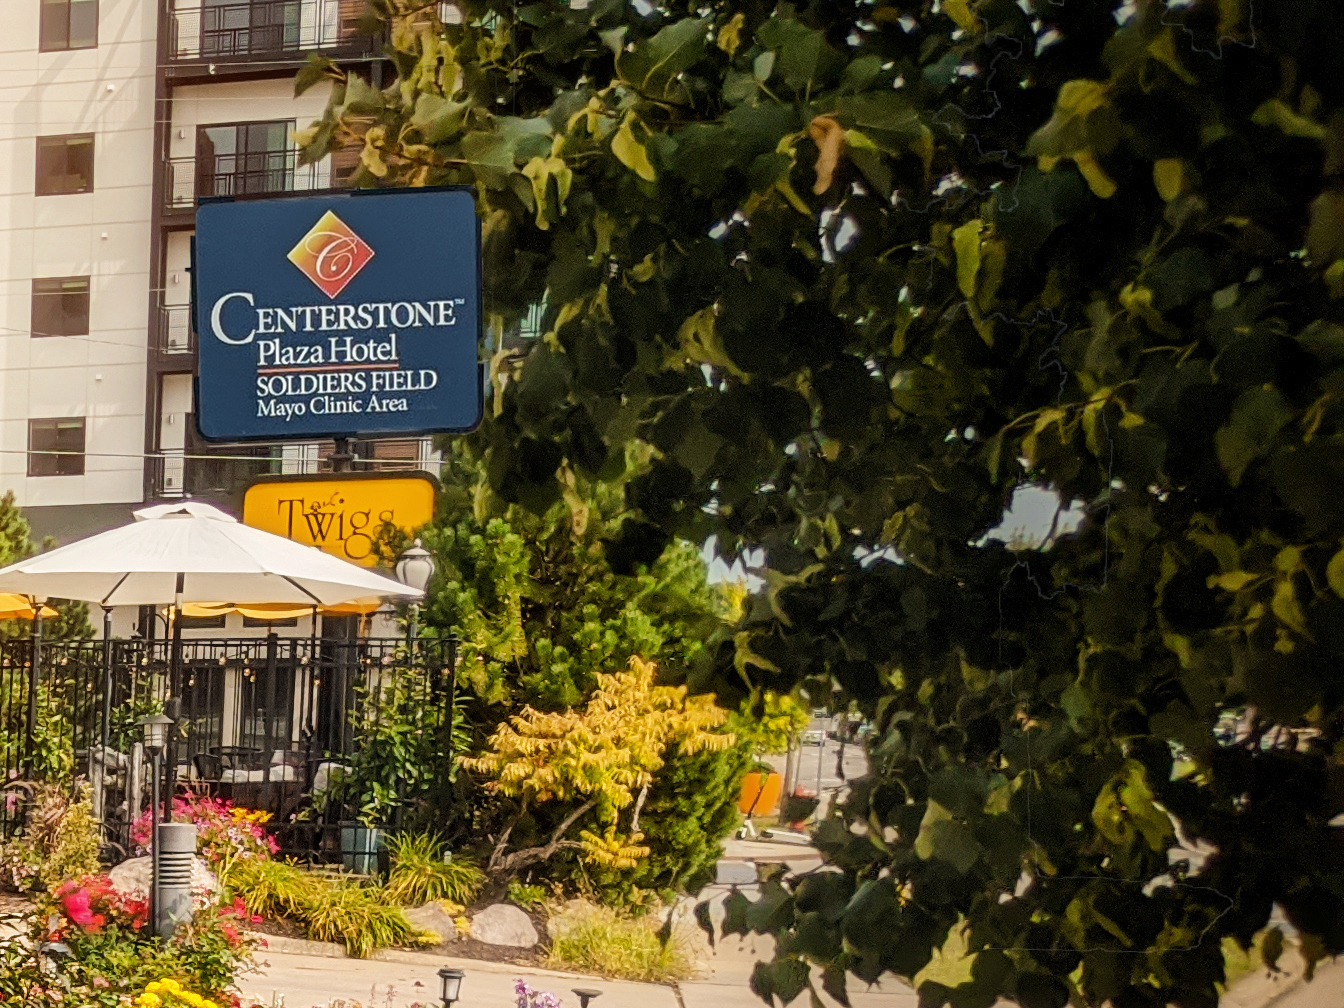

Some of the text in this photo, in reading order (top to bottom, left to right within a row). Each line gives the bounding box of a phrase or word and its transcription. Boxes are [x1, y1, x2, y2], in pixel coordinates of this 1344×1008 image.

[257, 333, 398, 366] Plaza Hotel
[257, 369, 438, 397] SOLDIERS FIELD
[257, 394, 409, 422] Mayo Clinic Area
